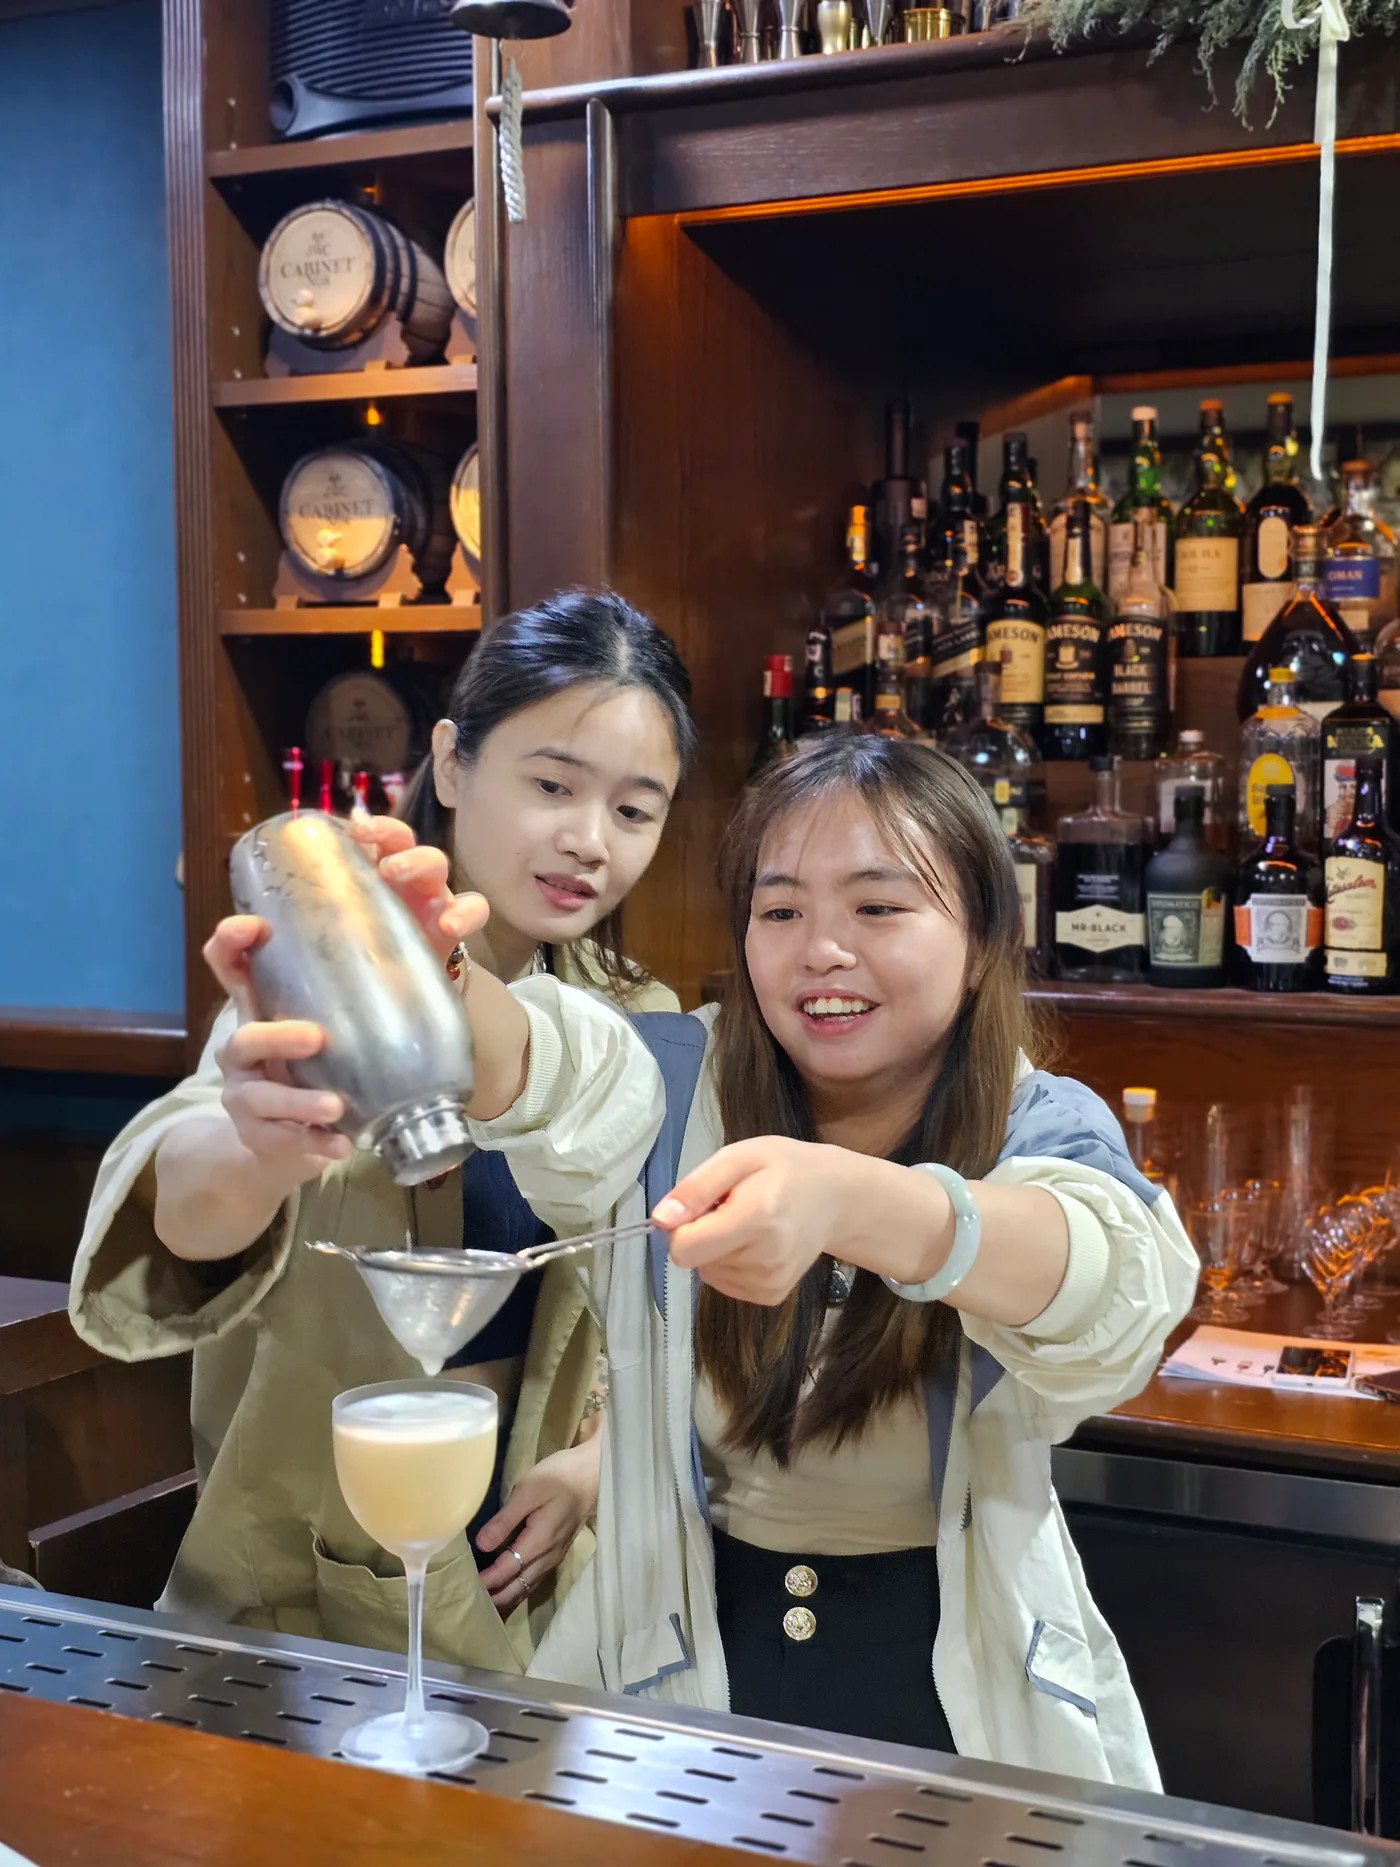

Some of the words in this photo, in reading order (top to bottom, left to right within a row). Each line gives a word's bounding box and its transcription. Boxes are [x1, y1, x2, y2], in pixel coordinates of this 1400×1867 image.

[280, 256, 356, 281] CABINET
[299, 498, 374, 519] CABINET
[988, 627, 1040, 644] AMESON
[1047, 623, 1101, 643] AMESON
[1091, 923, 1127, 933] BLACK
